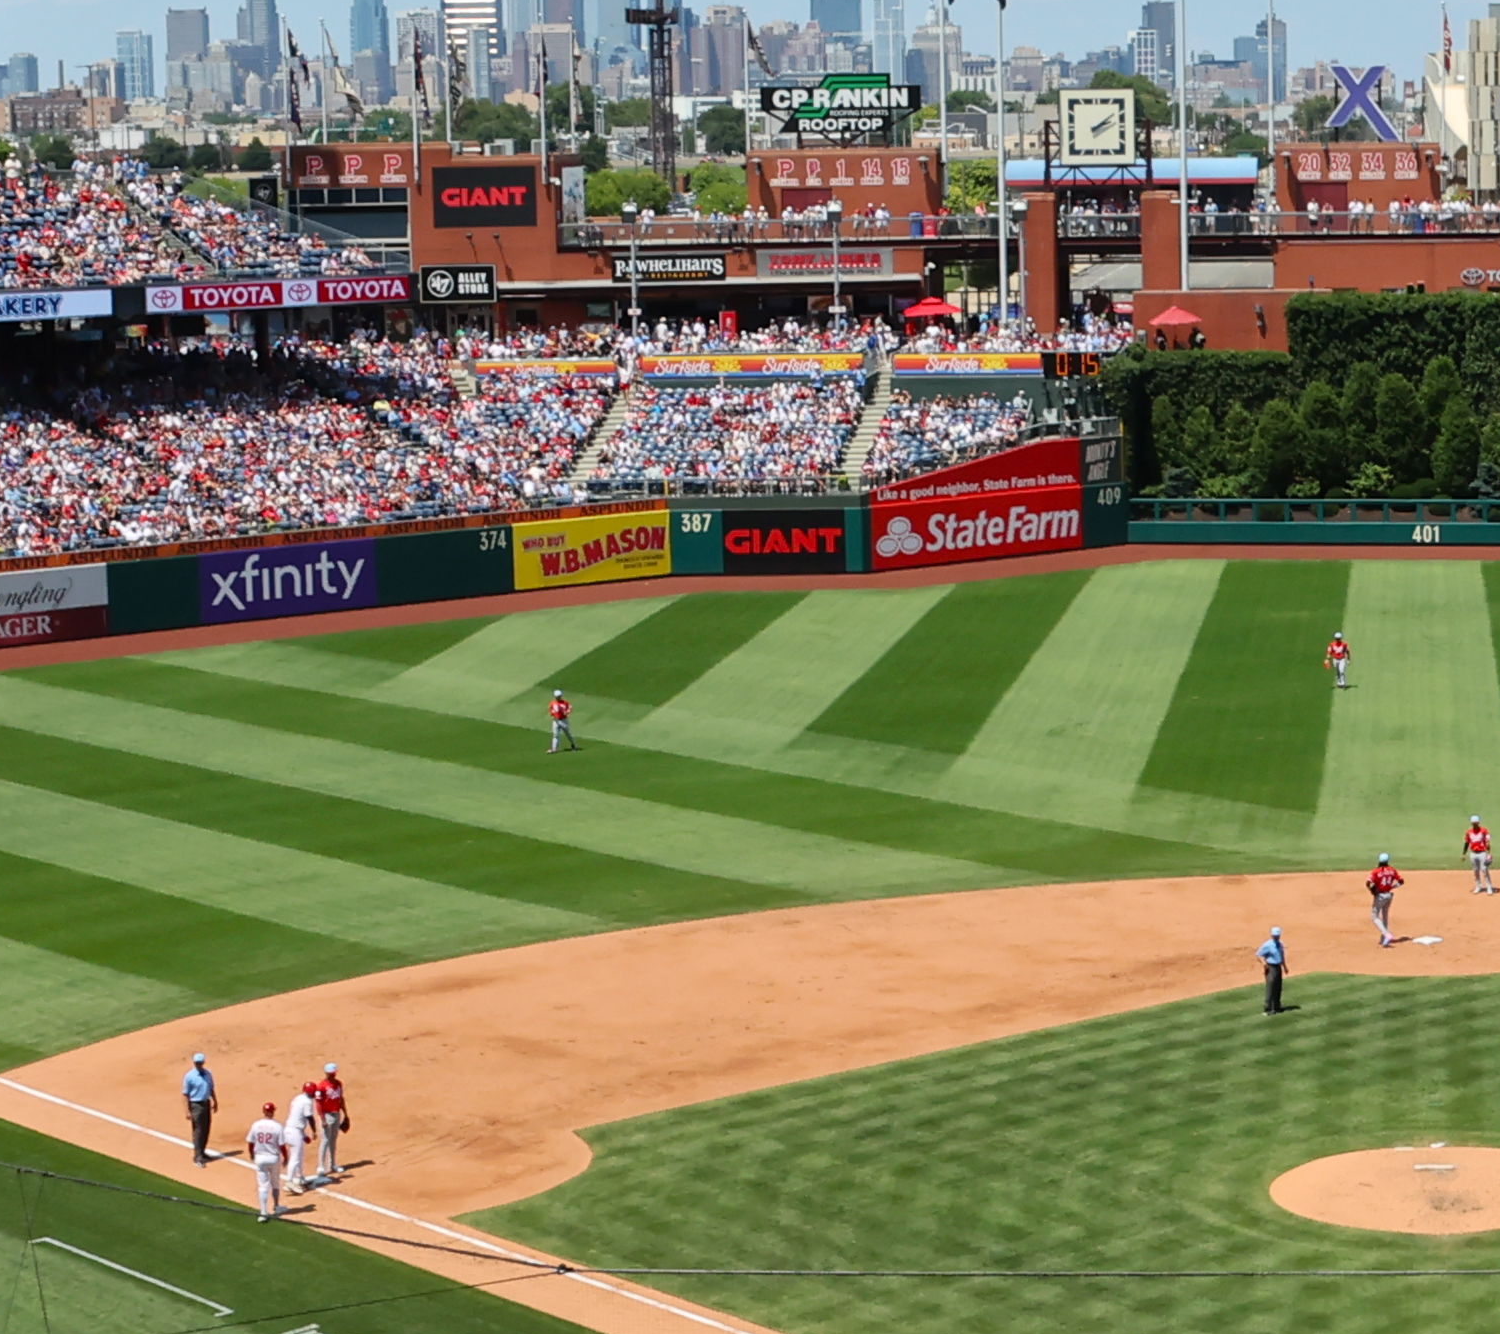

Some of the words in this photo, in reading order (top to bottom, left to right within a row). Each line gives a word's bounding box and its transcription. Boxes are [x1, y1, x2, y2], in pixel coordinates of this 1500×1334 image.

[772, 88, 809, 109] CP
[812, 87, 909, 108] RANKIN
[797, 117, 884, 132] ROOFTOP
[440, 185, 528, 208] GIANT
[457, 272, 488, 284] ALLEY
[189, 284, 277, 309] TOYOTA
[457, 282, 490, 296] STORE
[654, 357, 712, 377] Surfside
[924, 354, 980, 374] Surfside
[1055, 352, 1101, 377] 0:15
[877, 489, 898, 501] Like
[909, 485, 935, 501] good
[983, 478, 1010, 492] State
[1011, 475, 1037, 488] Farm
[1037, 474, 1047, 486] is
[1097, 486, 1122, 507] 409
[680, 513, 713, 534] 387
[1410, 524, 1442, 544] 401
[479, 530, 508, 551] 374
[724, 527, 843, 555] GIANT
[211, 550, 366, 612] xfinity
